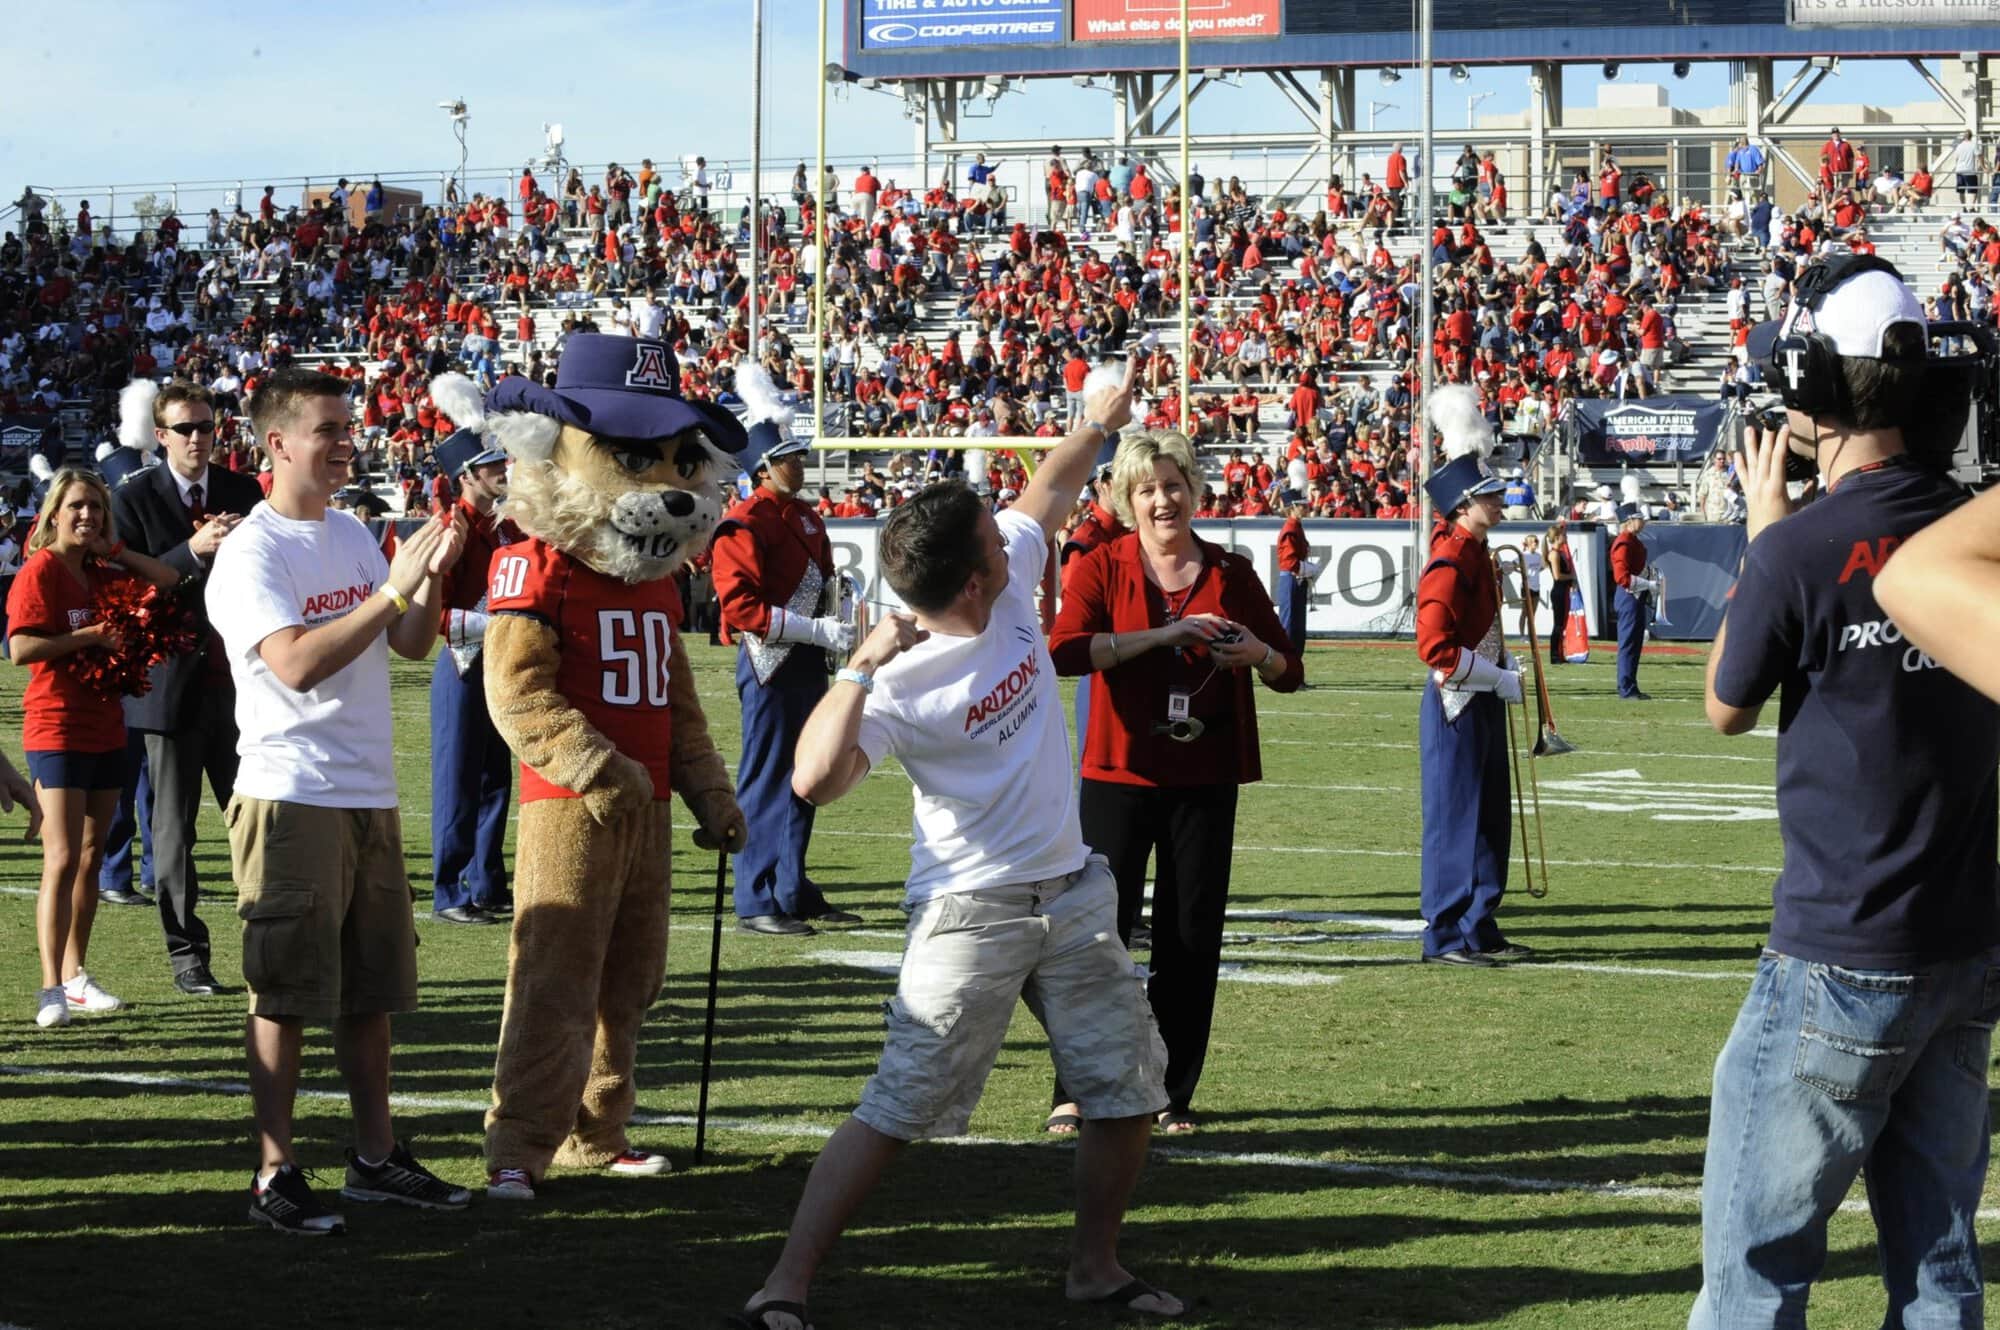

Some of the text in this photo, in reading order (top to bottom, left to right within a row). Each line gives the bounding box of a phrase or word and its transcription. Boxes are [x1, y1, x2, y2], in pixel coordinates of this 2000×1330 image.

[1087, 14, 1265, 33] What else do you need?
[625, 343, 672, 390] A
[1607, 415, 1695, 425] AMERICAN FAMILY
[492, 556, 528, 599] 50
[598, 609, 672, 708] 50
[965, 648, 1037, 733] ARIZON
[998, 695, 1038, 746] ALUMNI
